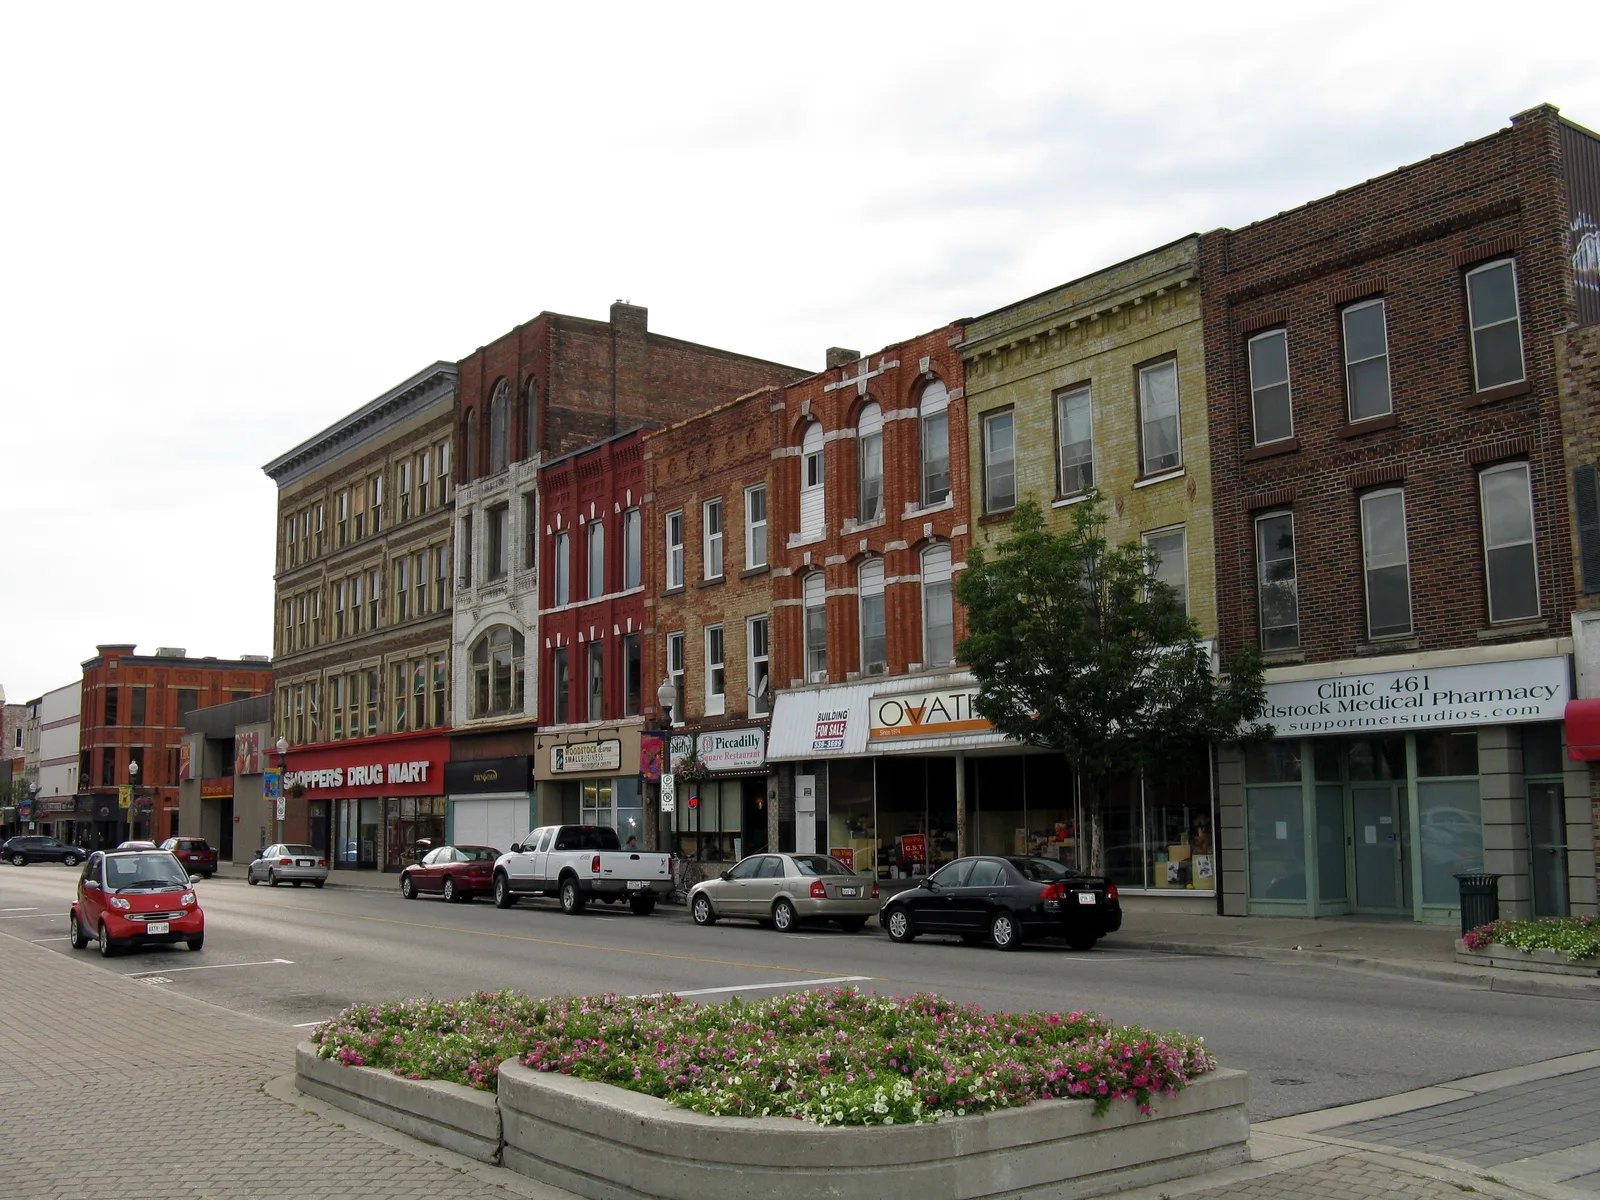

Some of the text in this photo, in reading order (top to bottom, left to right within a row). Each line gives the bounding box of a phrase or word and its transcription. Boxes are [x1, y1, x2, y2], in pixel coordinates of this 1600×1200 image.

[1317, 675, 1430, 699] Clinic 461
[1338, 693, 1424, 713] Medical
[1432, 684, 1560, 706] Pharmacy
[817, 710, 847, 721] BUILDING
[1240, 705, 1540, 734] .supportnetstudios.com
[817, 723, 845, 737] FOR SALE
[715, 734, 760, 750] Piccadilly
[565, 745, 597, 756] WOODSTOCK
[724, 750, 760, 760] Restaurant
[284, 761, 429, 790] SHOPPERS DRUG MART
